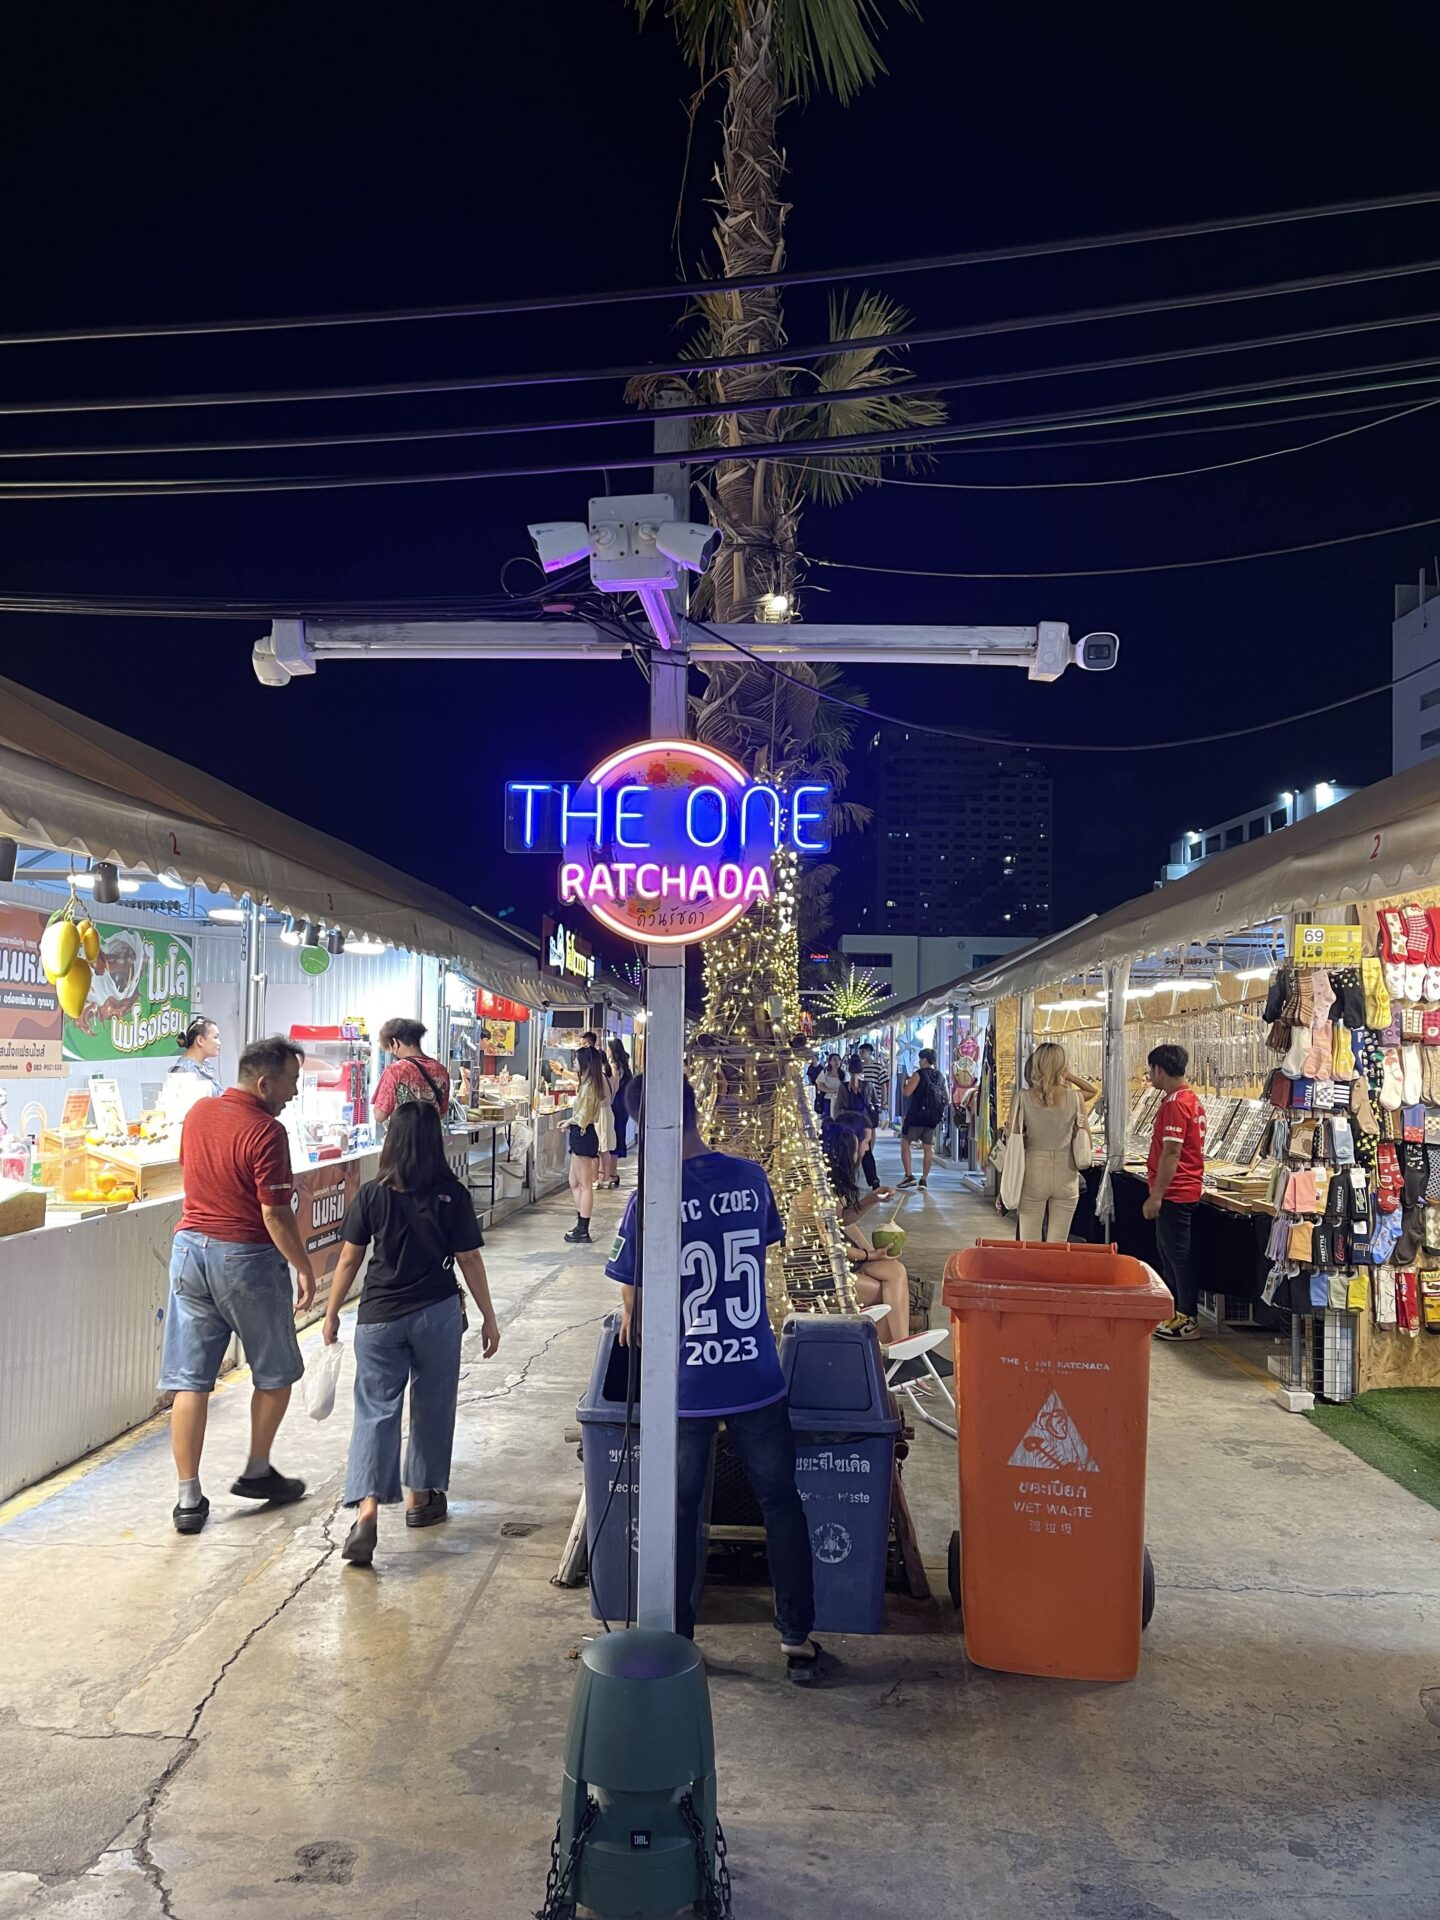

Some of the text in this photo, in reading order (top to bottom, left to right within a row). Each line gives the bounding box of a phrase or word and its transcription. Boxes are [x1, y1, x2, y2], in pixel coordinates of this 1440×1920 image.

[509, 784, 829, 850] THE ONE
[1370, 833, 1380, 860] 2
[560, 862, 770, 900] RATCHADA
[1304, 929, 1324, 943] 69
[1301, 945, 1323, 958] 120
[144, 942, 188, 1001] ไมโล
[709, 1188, 759, 1217] (ZOE)
[681, 1228, 761, 1336] 25
[685, 1336, 760, 1366] 2023
[1000, 1356, 1020, 1366] THE
[1013, 1500, 1041, 1514] WET
[633, 1835, 649, 1846] JBL
